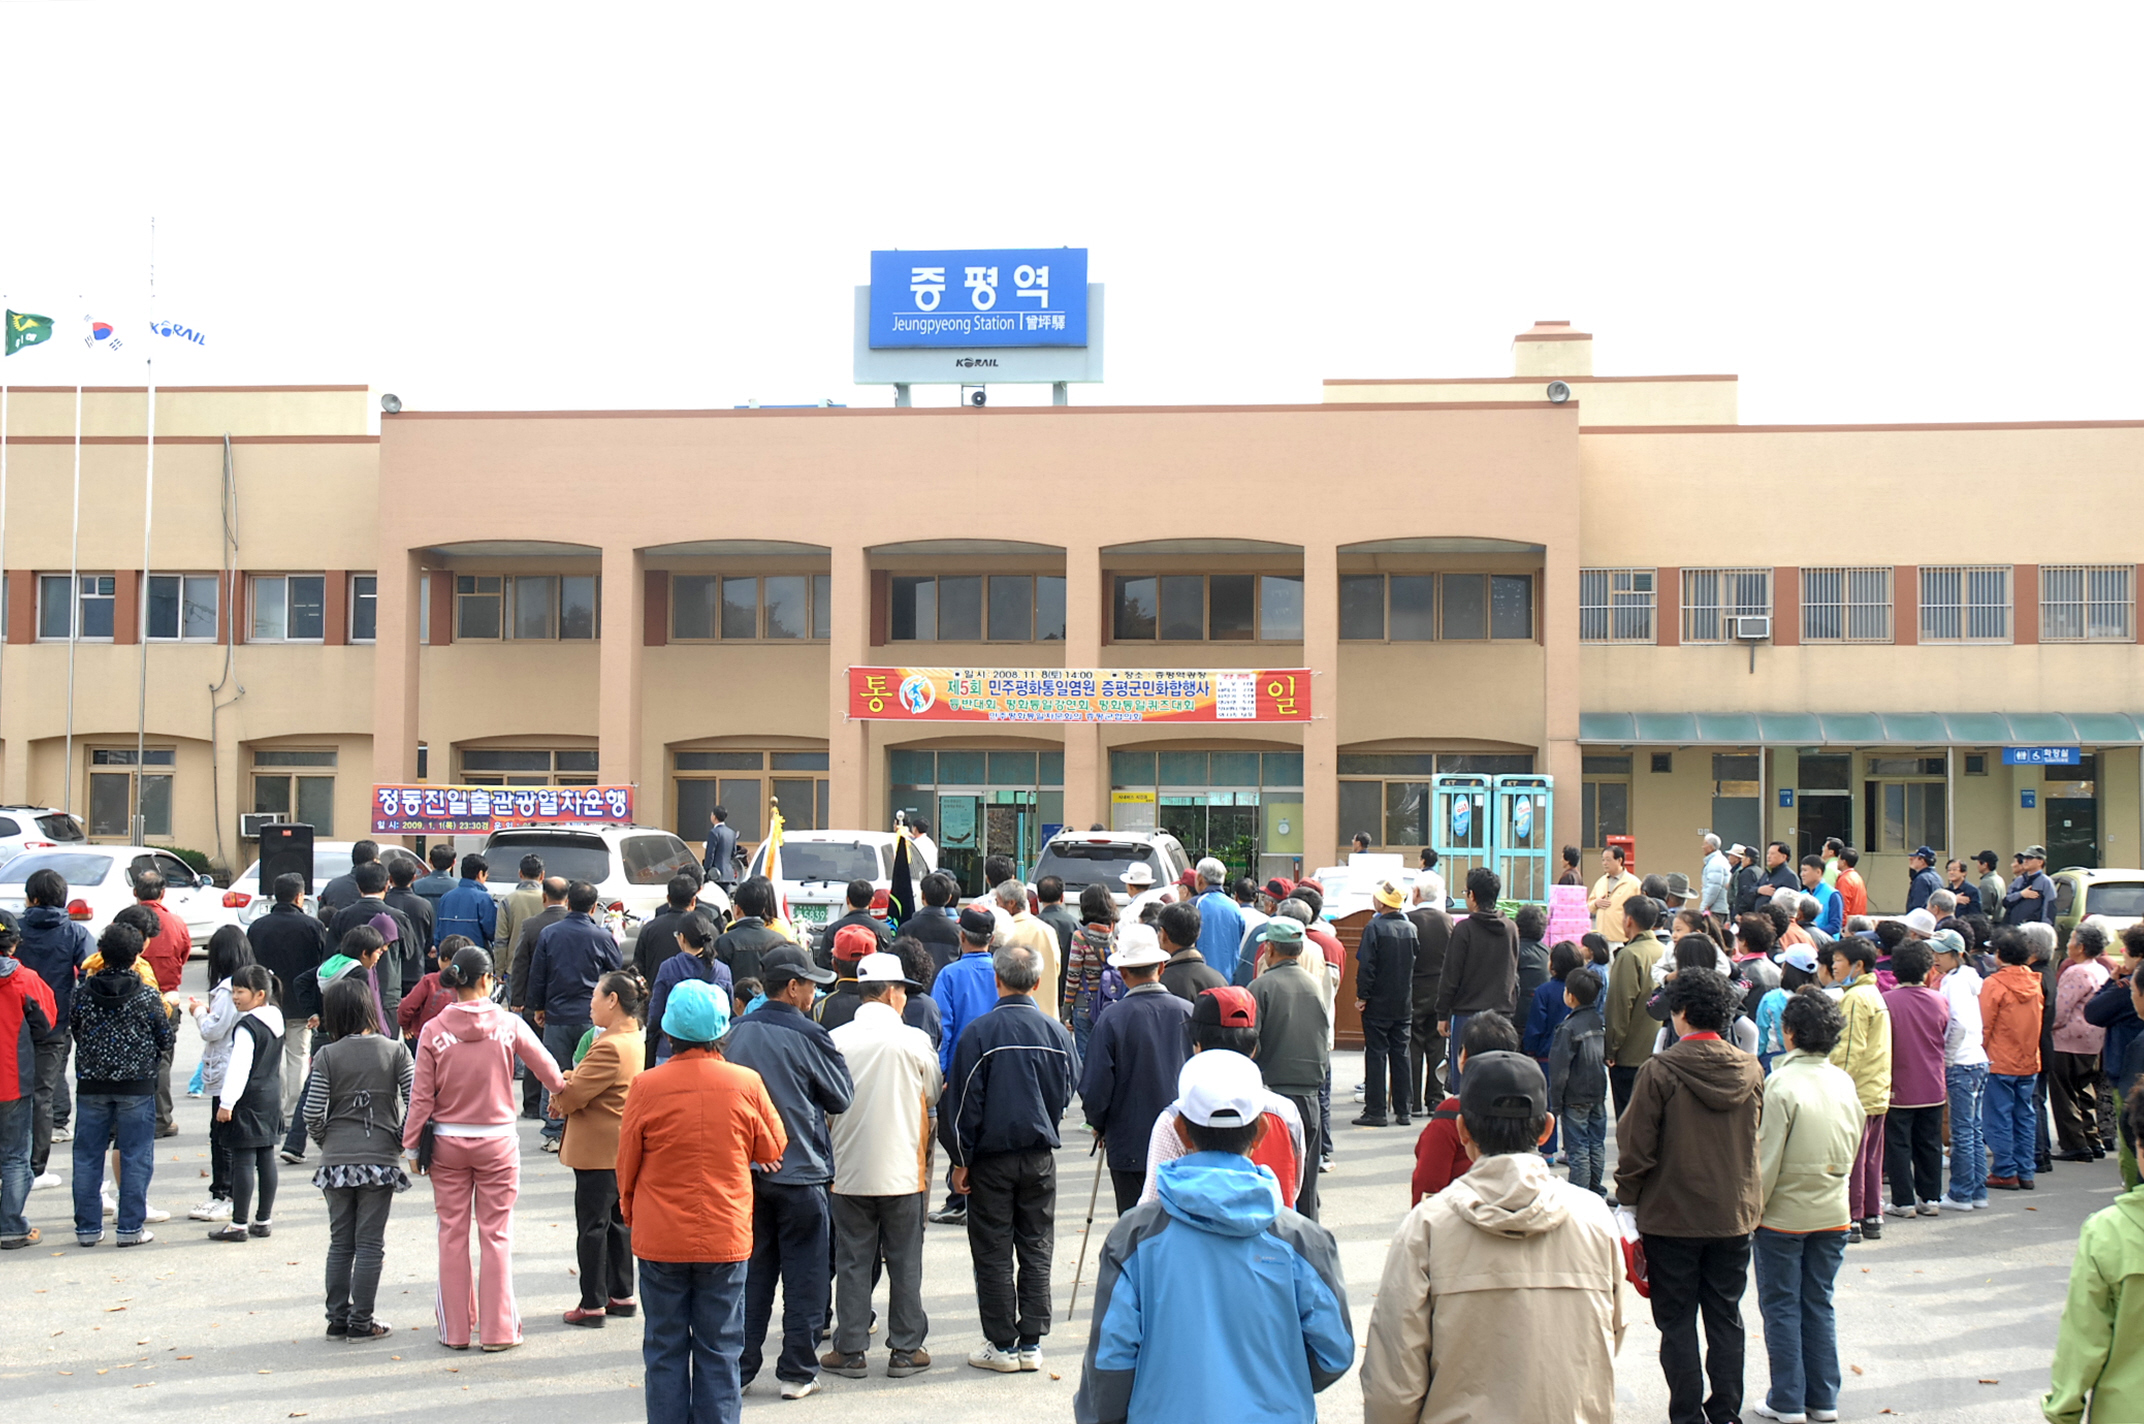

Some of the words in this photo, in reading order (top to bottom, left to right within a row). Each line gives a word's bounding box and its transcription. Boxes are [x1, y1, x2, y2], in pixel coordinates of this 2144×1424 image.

[910, 264, 1049, 312] 증평역
[892, 315, 971, 335] Jeungpyeong
[974, 315, 1014, 331] Station
[955, 357, 999, 368] KORAIL
[1066, 671, 1093, 679] 14:00
[859, 675, 893, 713] 통
[947, 679, 982, 696] 제5회
[989, 680, 1095, 697] 민주평화통일염원
[1101, 680, 1210, 697] 증평군민화합행사
[1267, 675, 1299, 714] 일
[378, 788, 628, 818] 정동진일출관광열차운행
